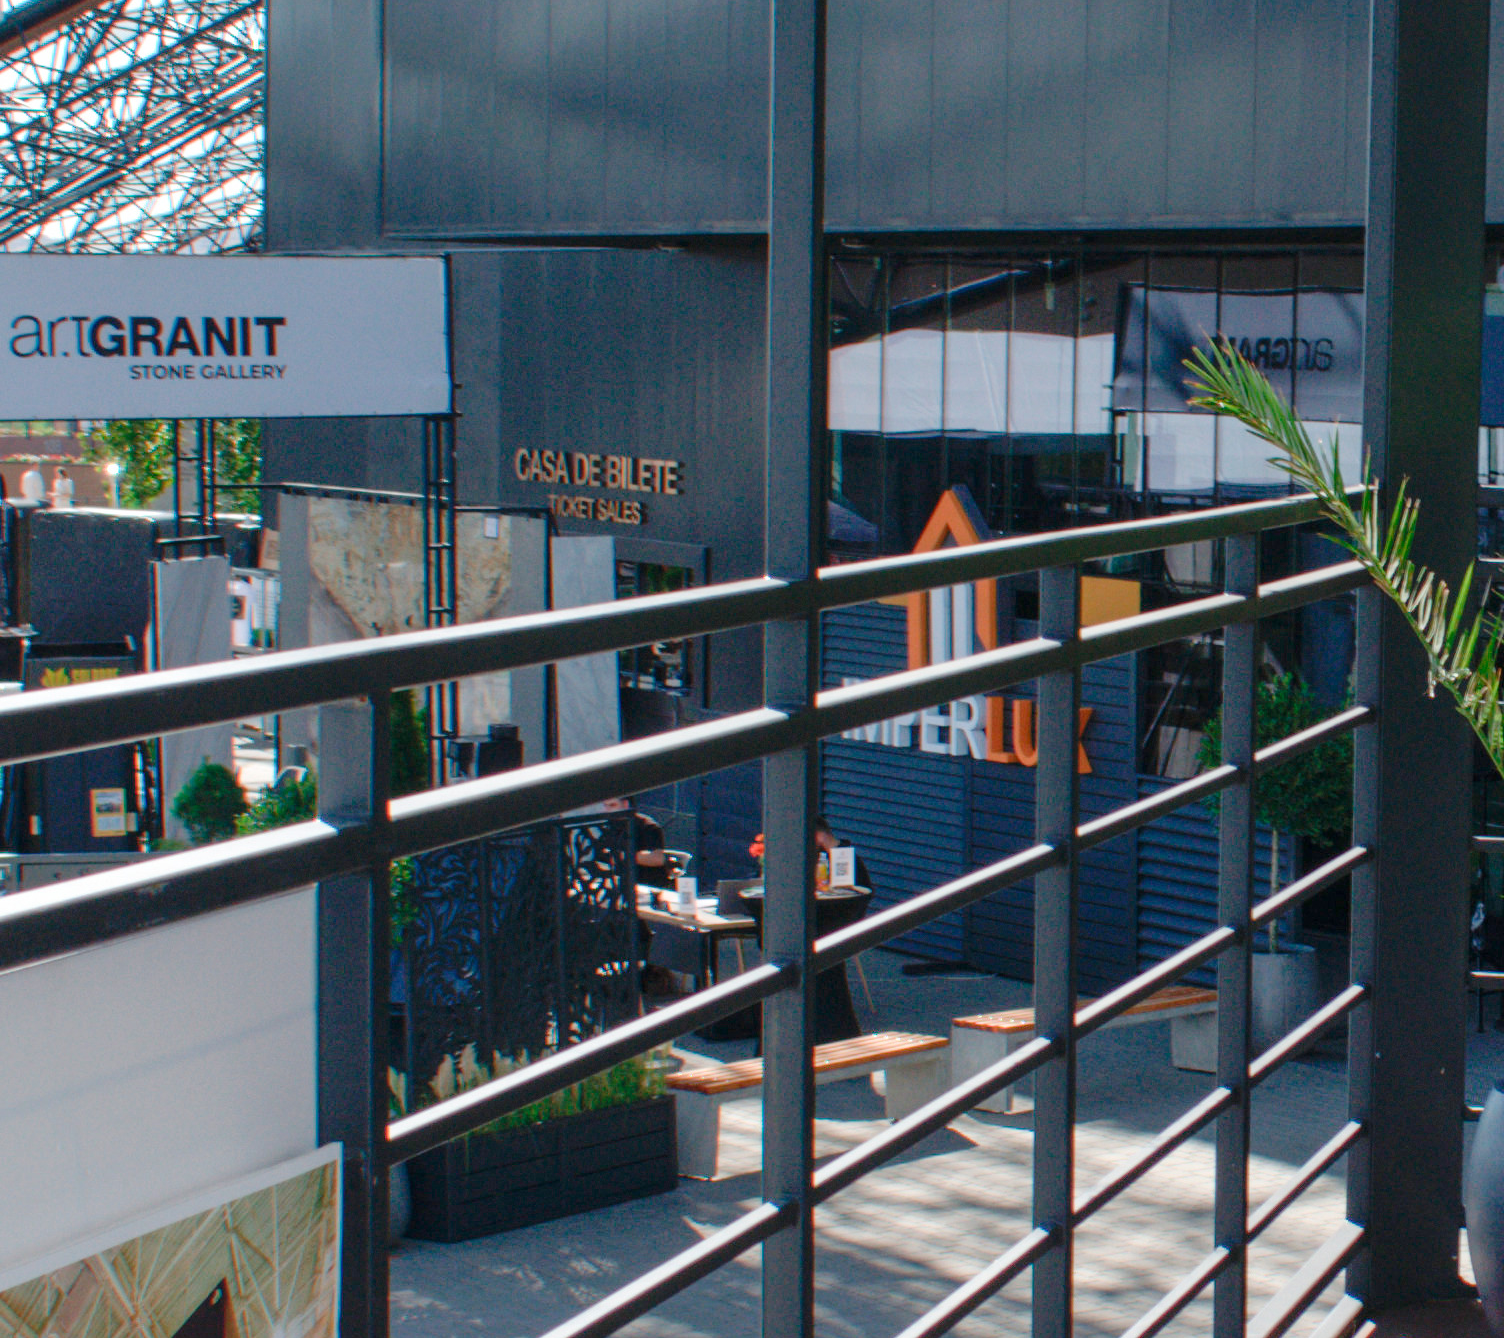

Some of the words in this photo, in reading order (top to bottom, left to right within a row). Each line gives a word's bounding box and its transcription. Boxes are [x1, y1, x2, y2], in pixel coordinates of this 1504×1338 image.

[129, 364, 195, 380] STONE
[200, 364, 287, 381] GALLERY
[515, 447, 569, 484] CASA
[574, 452, 601, 487] DE
[606, 455, 680, 495] BILETE
[547, 493, 596, 519] TICKET
[596, 497, 641, 526] SALES
